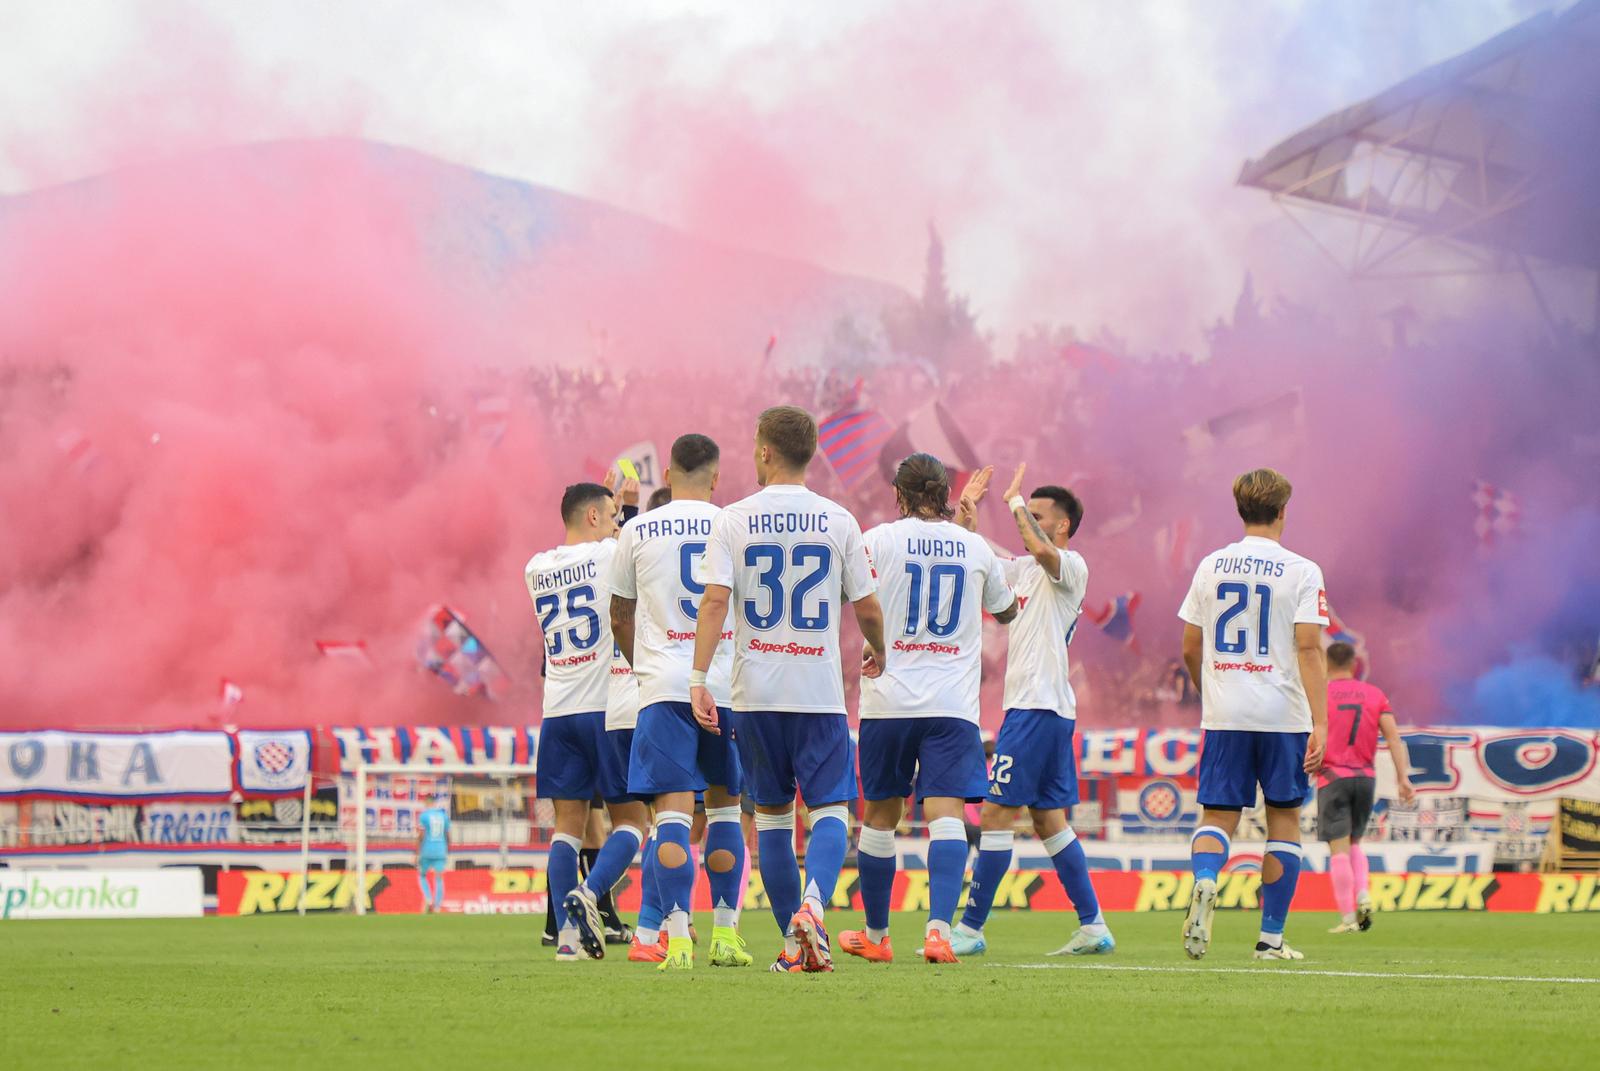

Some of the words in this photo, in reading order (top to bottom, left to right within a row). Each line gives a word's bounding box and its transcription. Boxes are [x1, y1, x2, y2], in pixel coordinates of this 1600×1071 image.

[748, 513, 829, 534] HRGOVIĆ
[907, 538, 966, 558] LIVAJA
[1214, 556, 1285, 577] PUKŠTAS
[744, 542, 834, 631] 32
[902, 561, 967, 637] 10
[535, 583, 602, 657] 25
[1214, 580, 1273, 656] 21
[748, 638, 825, 657] SuperSport
[892, 640, 960, 656] SuperSport
[1337, 703, 1362, 746] 7
[1366, 873, 1497, 911] RIZK
